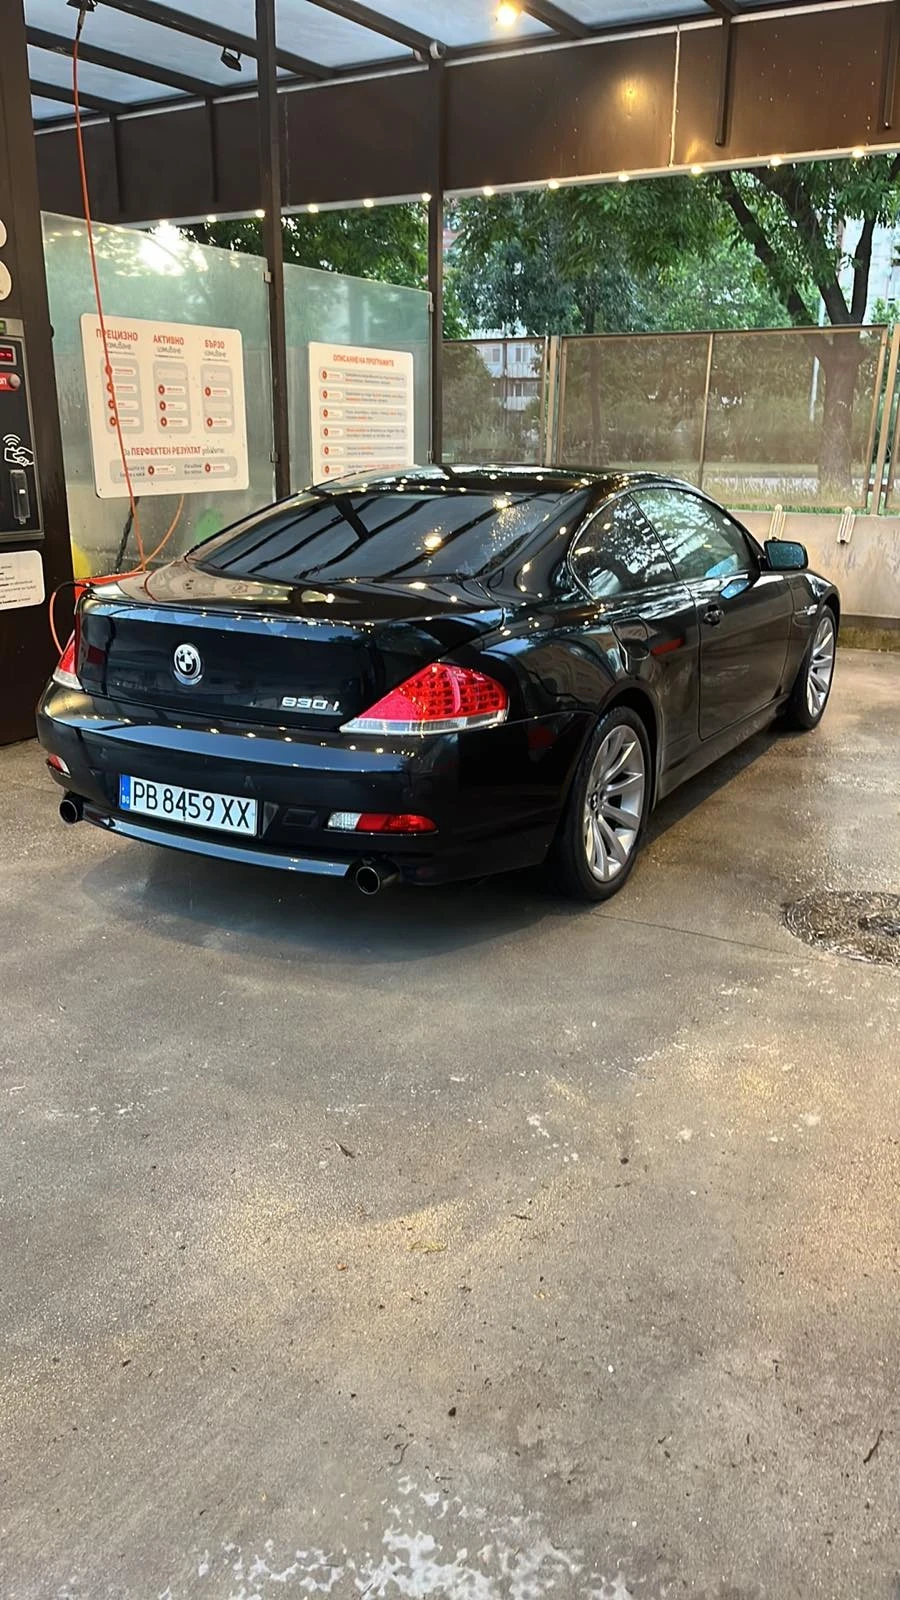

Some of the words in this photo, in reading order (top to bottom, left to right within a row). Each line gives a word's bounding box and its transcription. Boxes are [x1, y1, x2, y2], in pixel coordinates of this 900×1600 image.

[153, 334, 185, 346] АКТИВНО
[204, 339, 225, 350] БЪРЗО
[131, 446, 171, 456] ПЕРФЕКТЕН
[172, 445, 201, 455] РЕЗУЛТАТ
[133, 781, 158, 810] PB
[163, 788, 216, 822] 8459
[221, 797, 250, 829] XX
